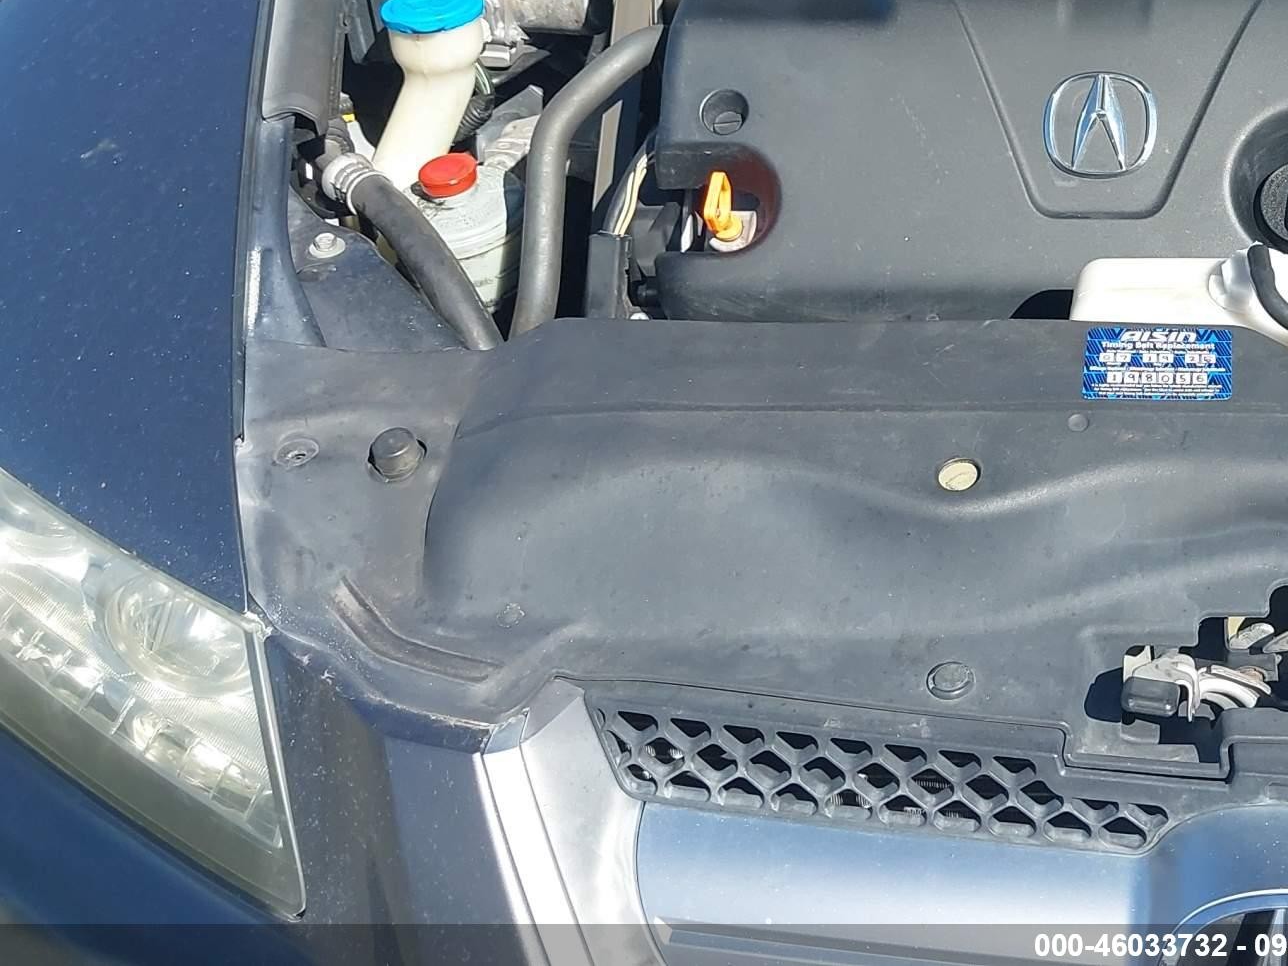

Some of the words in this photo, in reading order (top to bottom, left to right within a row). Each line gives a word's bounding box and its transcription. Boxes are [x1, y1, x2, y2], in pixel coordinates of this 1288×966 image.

[1102, 341, 1133, 350] Timing
[1135, 342, 1154, 350] Belt
[1156, 342, 1216, 351] Replacement
